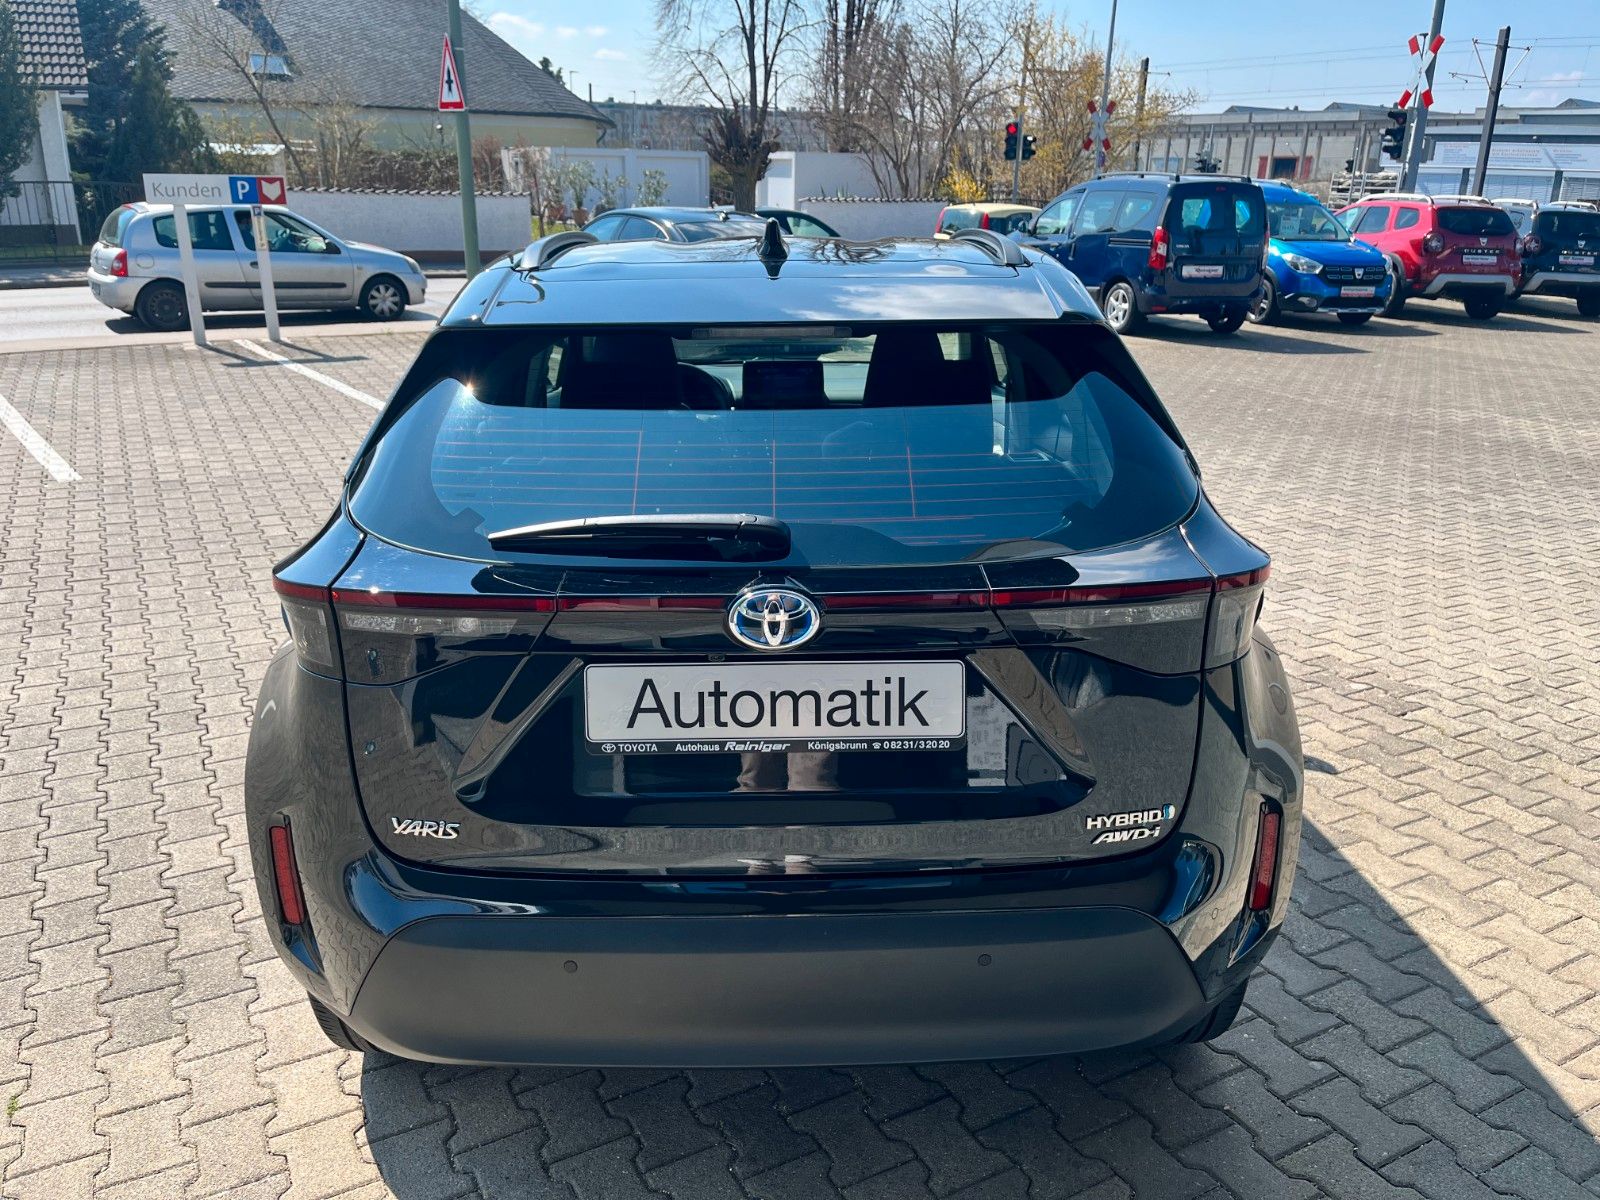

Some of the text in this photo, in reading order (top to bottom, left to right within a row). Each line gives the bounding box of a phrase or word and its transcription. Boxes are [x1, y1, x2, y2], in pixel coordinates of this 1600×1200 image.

[152, 180, 250, 200] Kunden P
[626, 676, 930, 729] Automatik
[617, 743, 658, 752] TOYOTA
[675, 743, 720, 752] Autohaus
[724, 741, 790, 753] Reiniger
[808, 741, 867, 751] Königsbrunn
[1086, 809, 1162, 830] HYBRID
[1092, 826, 1161, 845] AWD-i
